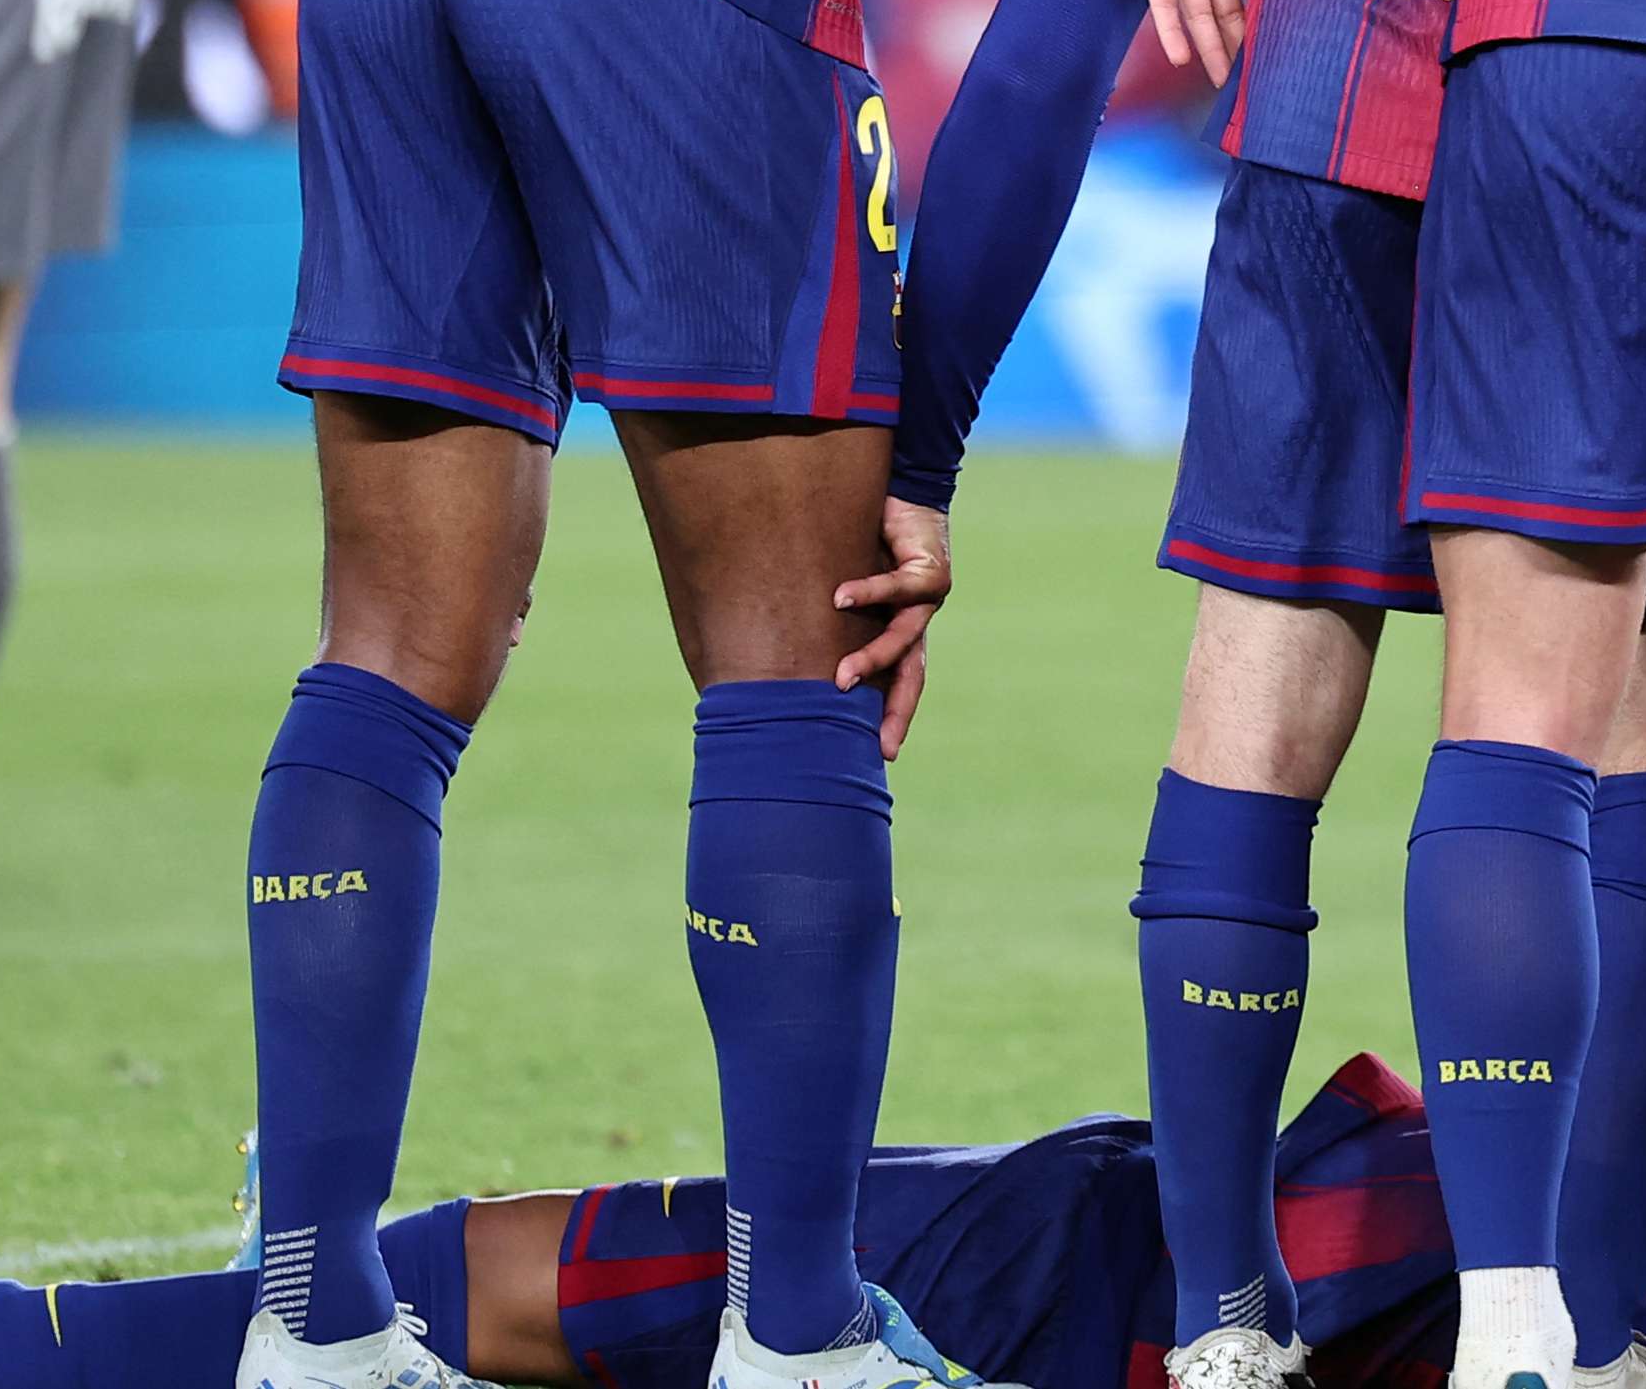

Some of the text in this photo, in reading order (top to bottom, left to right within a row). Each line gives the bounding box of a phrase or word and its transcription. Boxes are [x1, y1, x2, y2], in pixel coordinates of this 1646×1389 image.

[252, 869, 369, 904] BARÇA
[1182, 978, 1300, 1014] BARÇA
[1438, 1058, 1553, 1085] BARÇA
